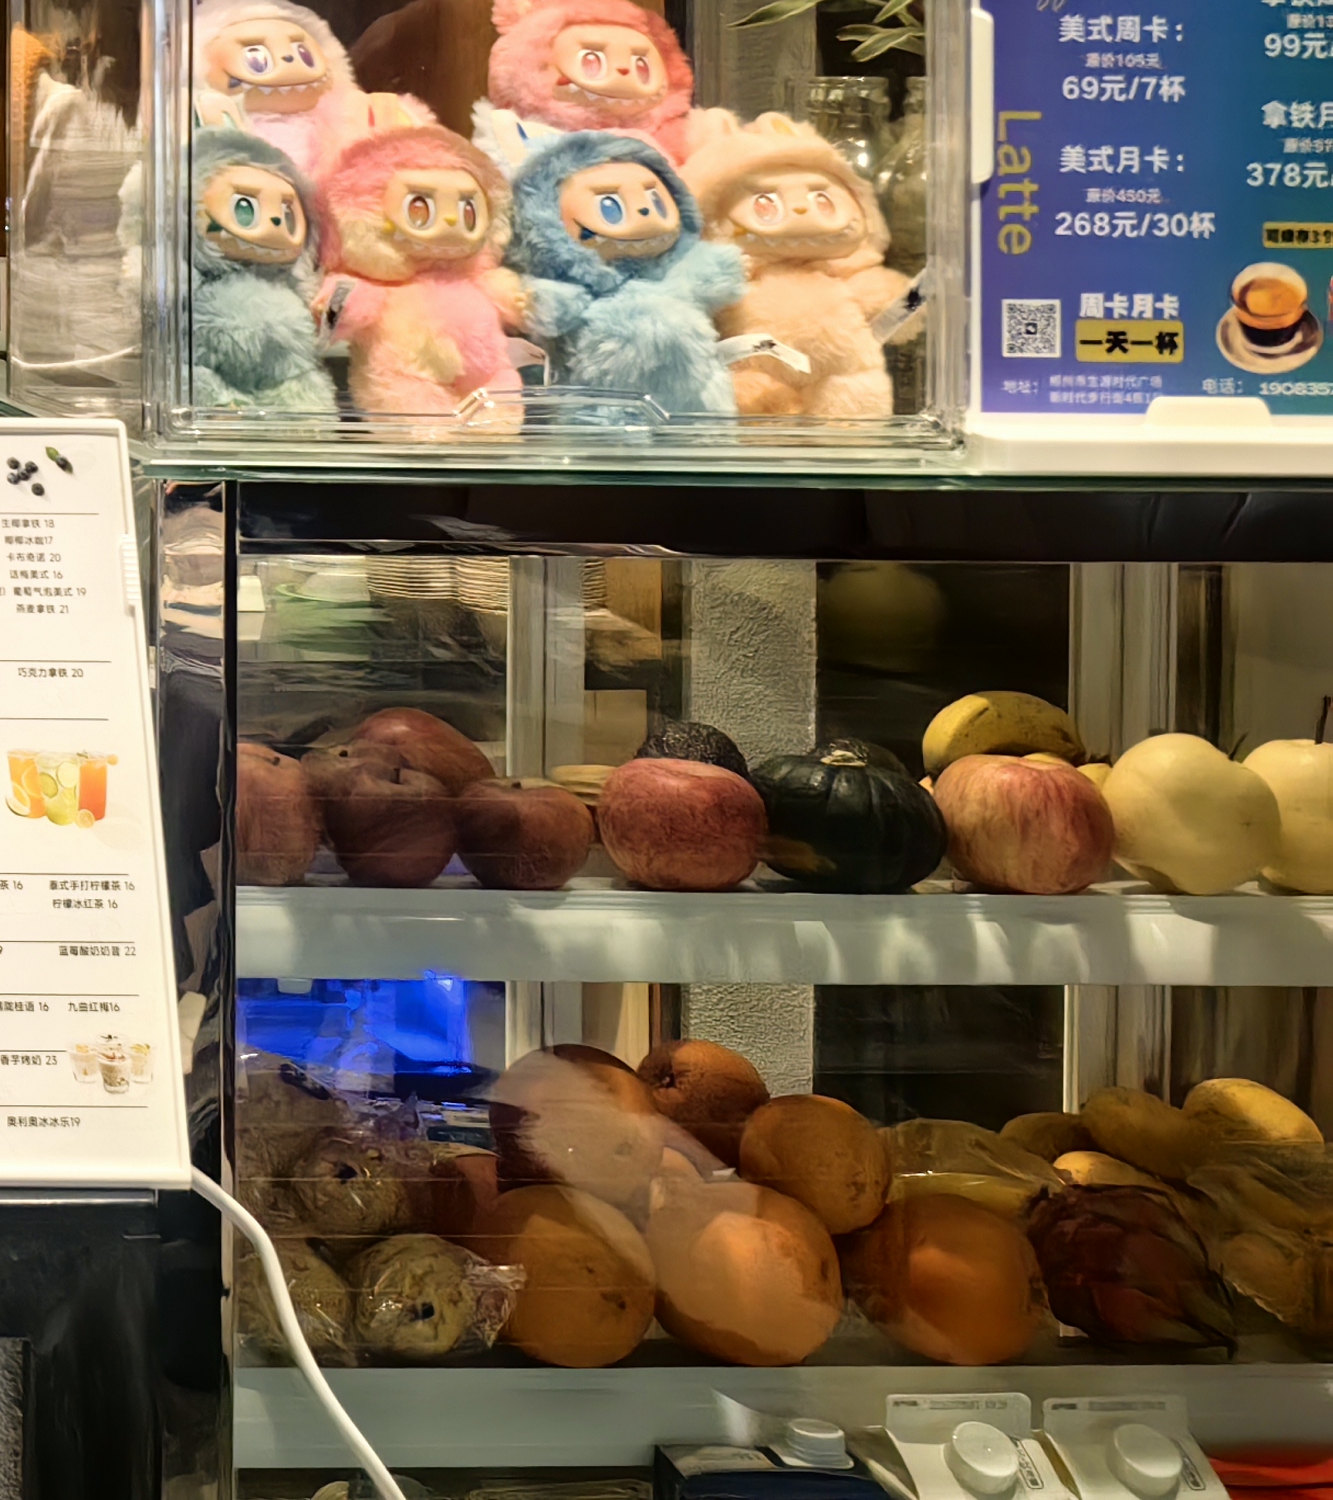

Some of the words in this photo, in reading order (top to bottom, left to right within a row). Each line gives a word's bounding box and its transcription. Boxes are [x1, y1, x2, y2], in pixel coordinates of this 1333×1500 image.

[1264, 33, 1333, 59] 99元
[1062, 75, 1186, 102] 69元/7杯
[997, 111, 1042, 256] Latte
[1246, 162, 1333, 188] 378元
[1054, 211, 1215, 239] 268元/30杯
[1080, 293, 1179, 319] 周卡月卡
[1079, 330, 1179, 355] 一天一杯
